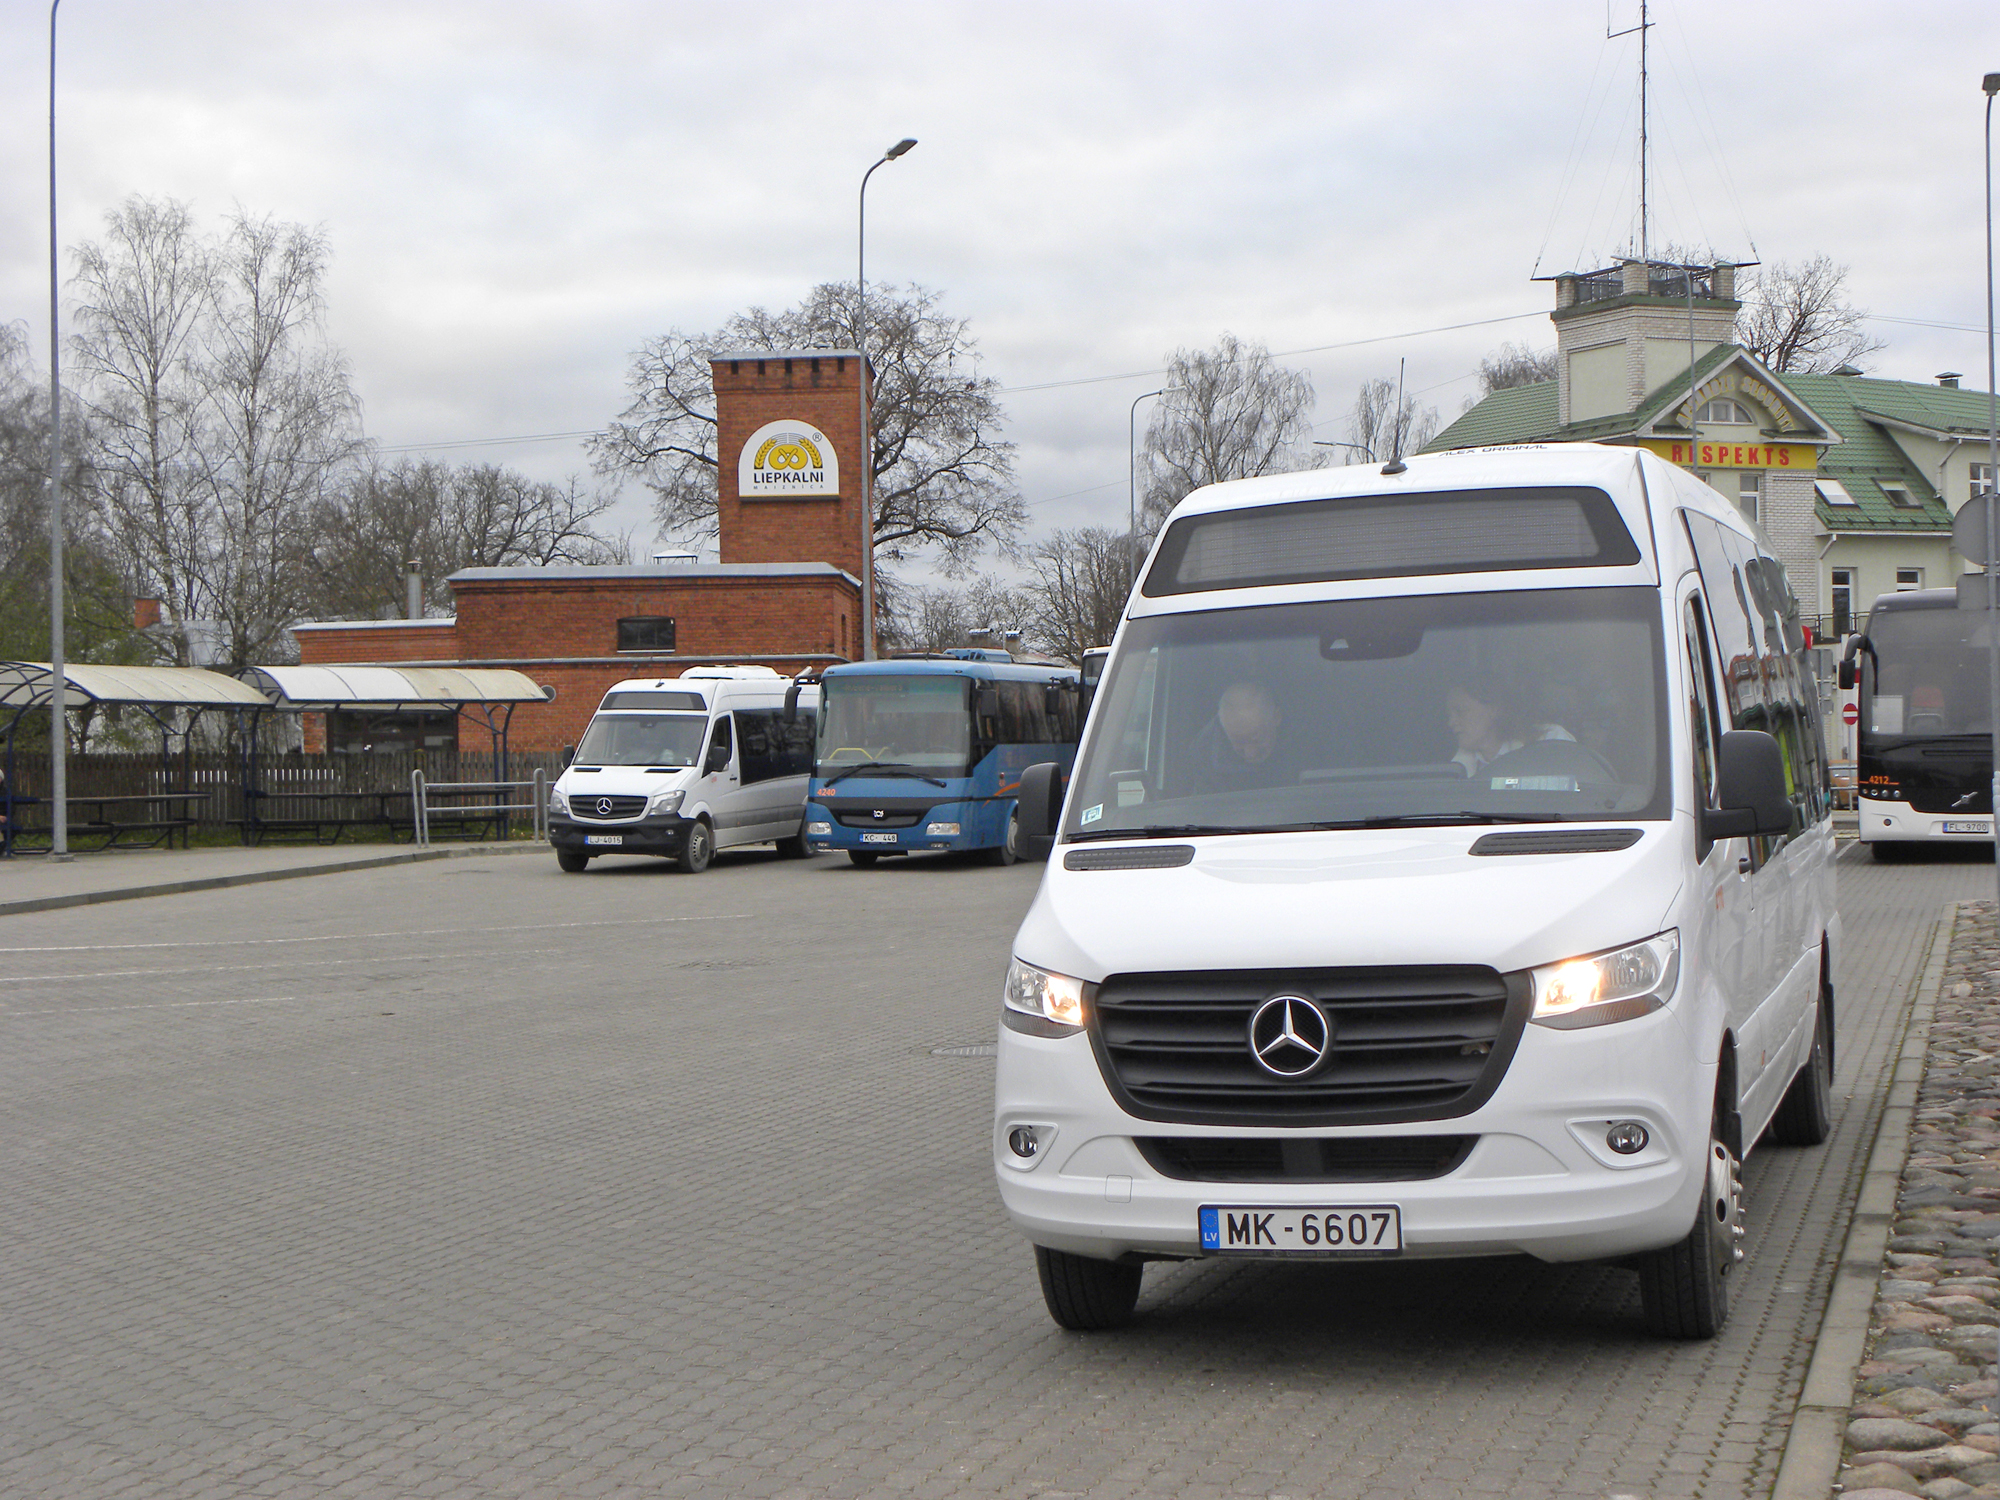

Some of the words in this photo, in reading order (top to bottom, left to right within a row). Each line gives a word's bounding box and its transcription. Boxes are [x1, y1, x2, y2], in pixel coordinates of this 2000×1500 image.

[1741, 375, 1795, 432] SECURITY
[1439, 448, 1476, 456] ALEX
[1482, 445, 1548, 453] ORIGINAL
[1672, 444, 1789, 465] RISPEKTS
[754, 472, 824, 483] LIEPKALNI
[1869, 776, 1889, 784] 4212
[817, 788, 836, 796] 4240
[1948, 823, 1987, 831] FL-9700
[1227, 1213, 1390, 1245] MK-6607
[1204, 1232, 1217, 1241] LV
